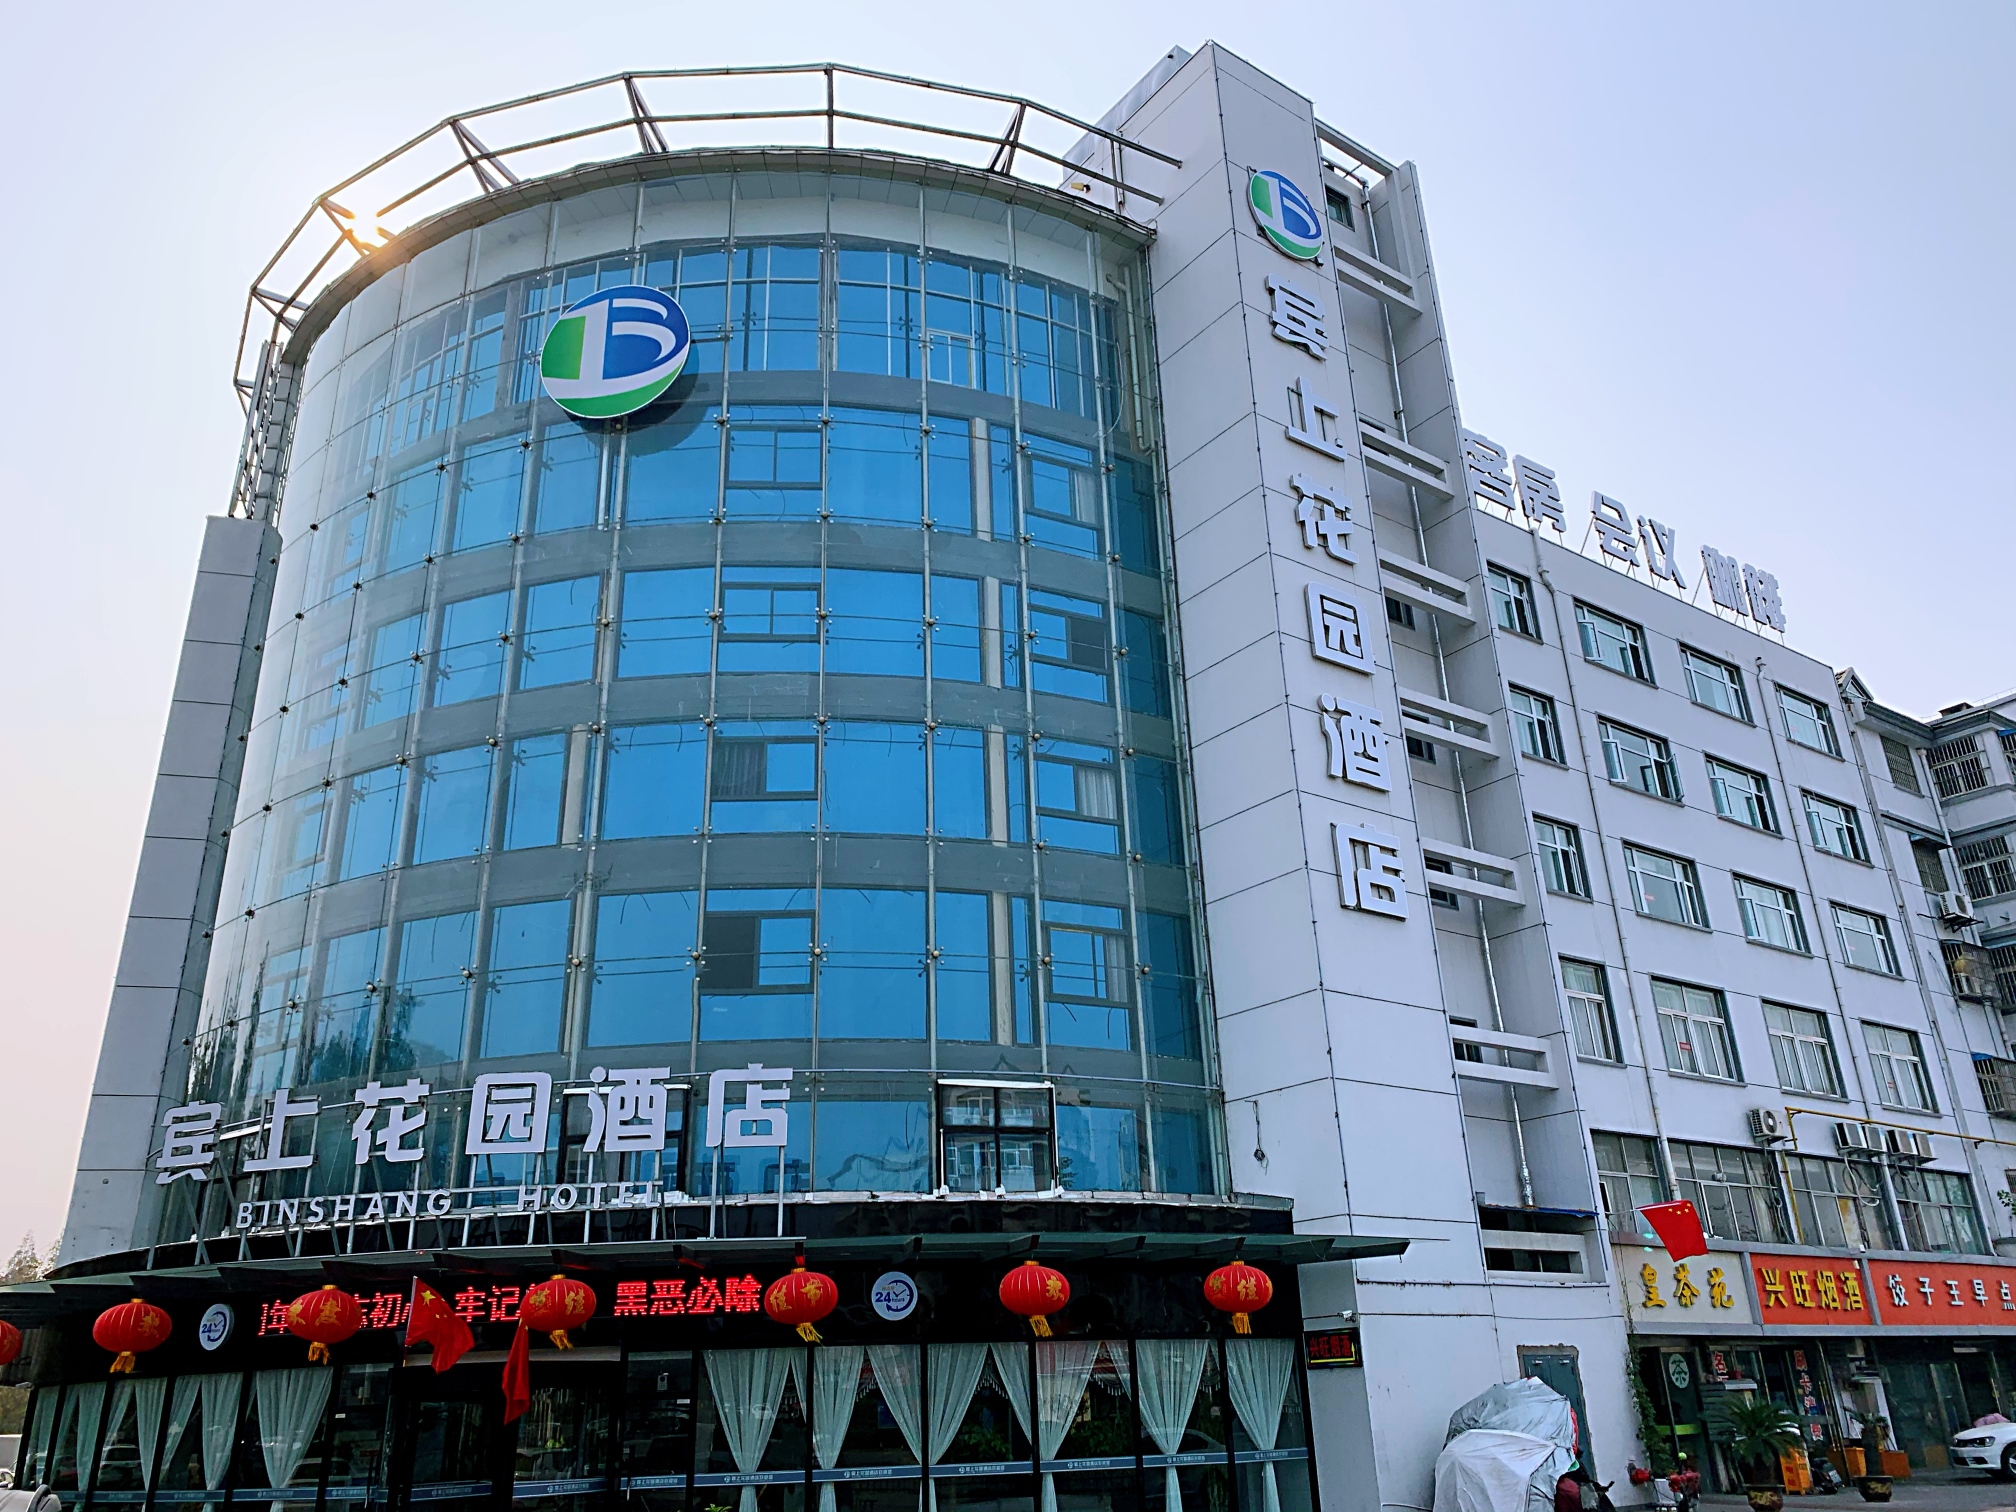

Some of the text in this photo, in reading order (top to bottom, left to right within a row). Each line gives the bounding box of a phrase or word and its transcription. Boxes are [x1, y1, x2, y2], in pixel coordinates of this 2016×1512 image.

[1265, 273, 1410, 922] 宾上花园酒店
[155, 1063, 794, 1186] 宾上花园酒店
[236, 1180, 662, 1229] BINSHANG HOTEL
[614, 1274, 762, 1316] 黑恶必除
[874, 1291, 891, 1304] 24
[1760, 1266, 1865, 1312] 兴旺烟酒
[1886, 1273, 2016, 1311] 饺子王早点
[201, 1323, 213, 1335] 24
